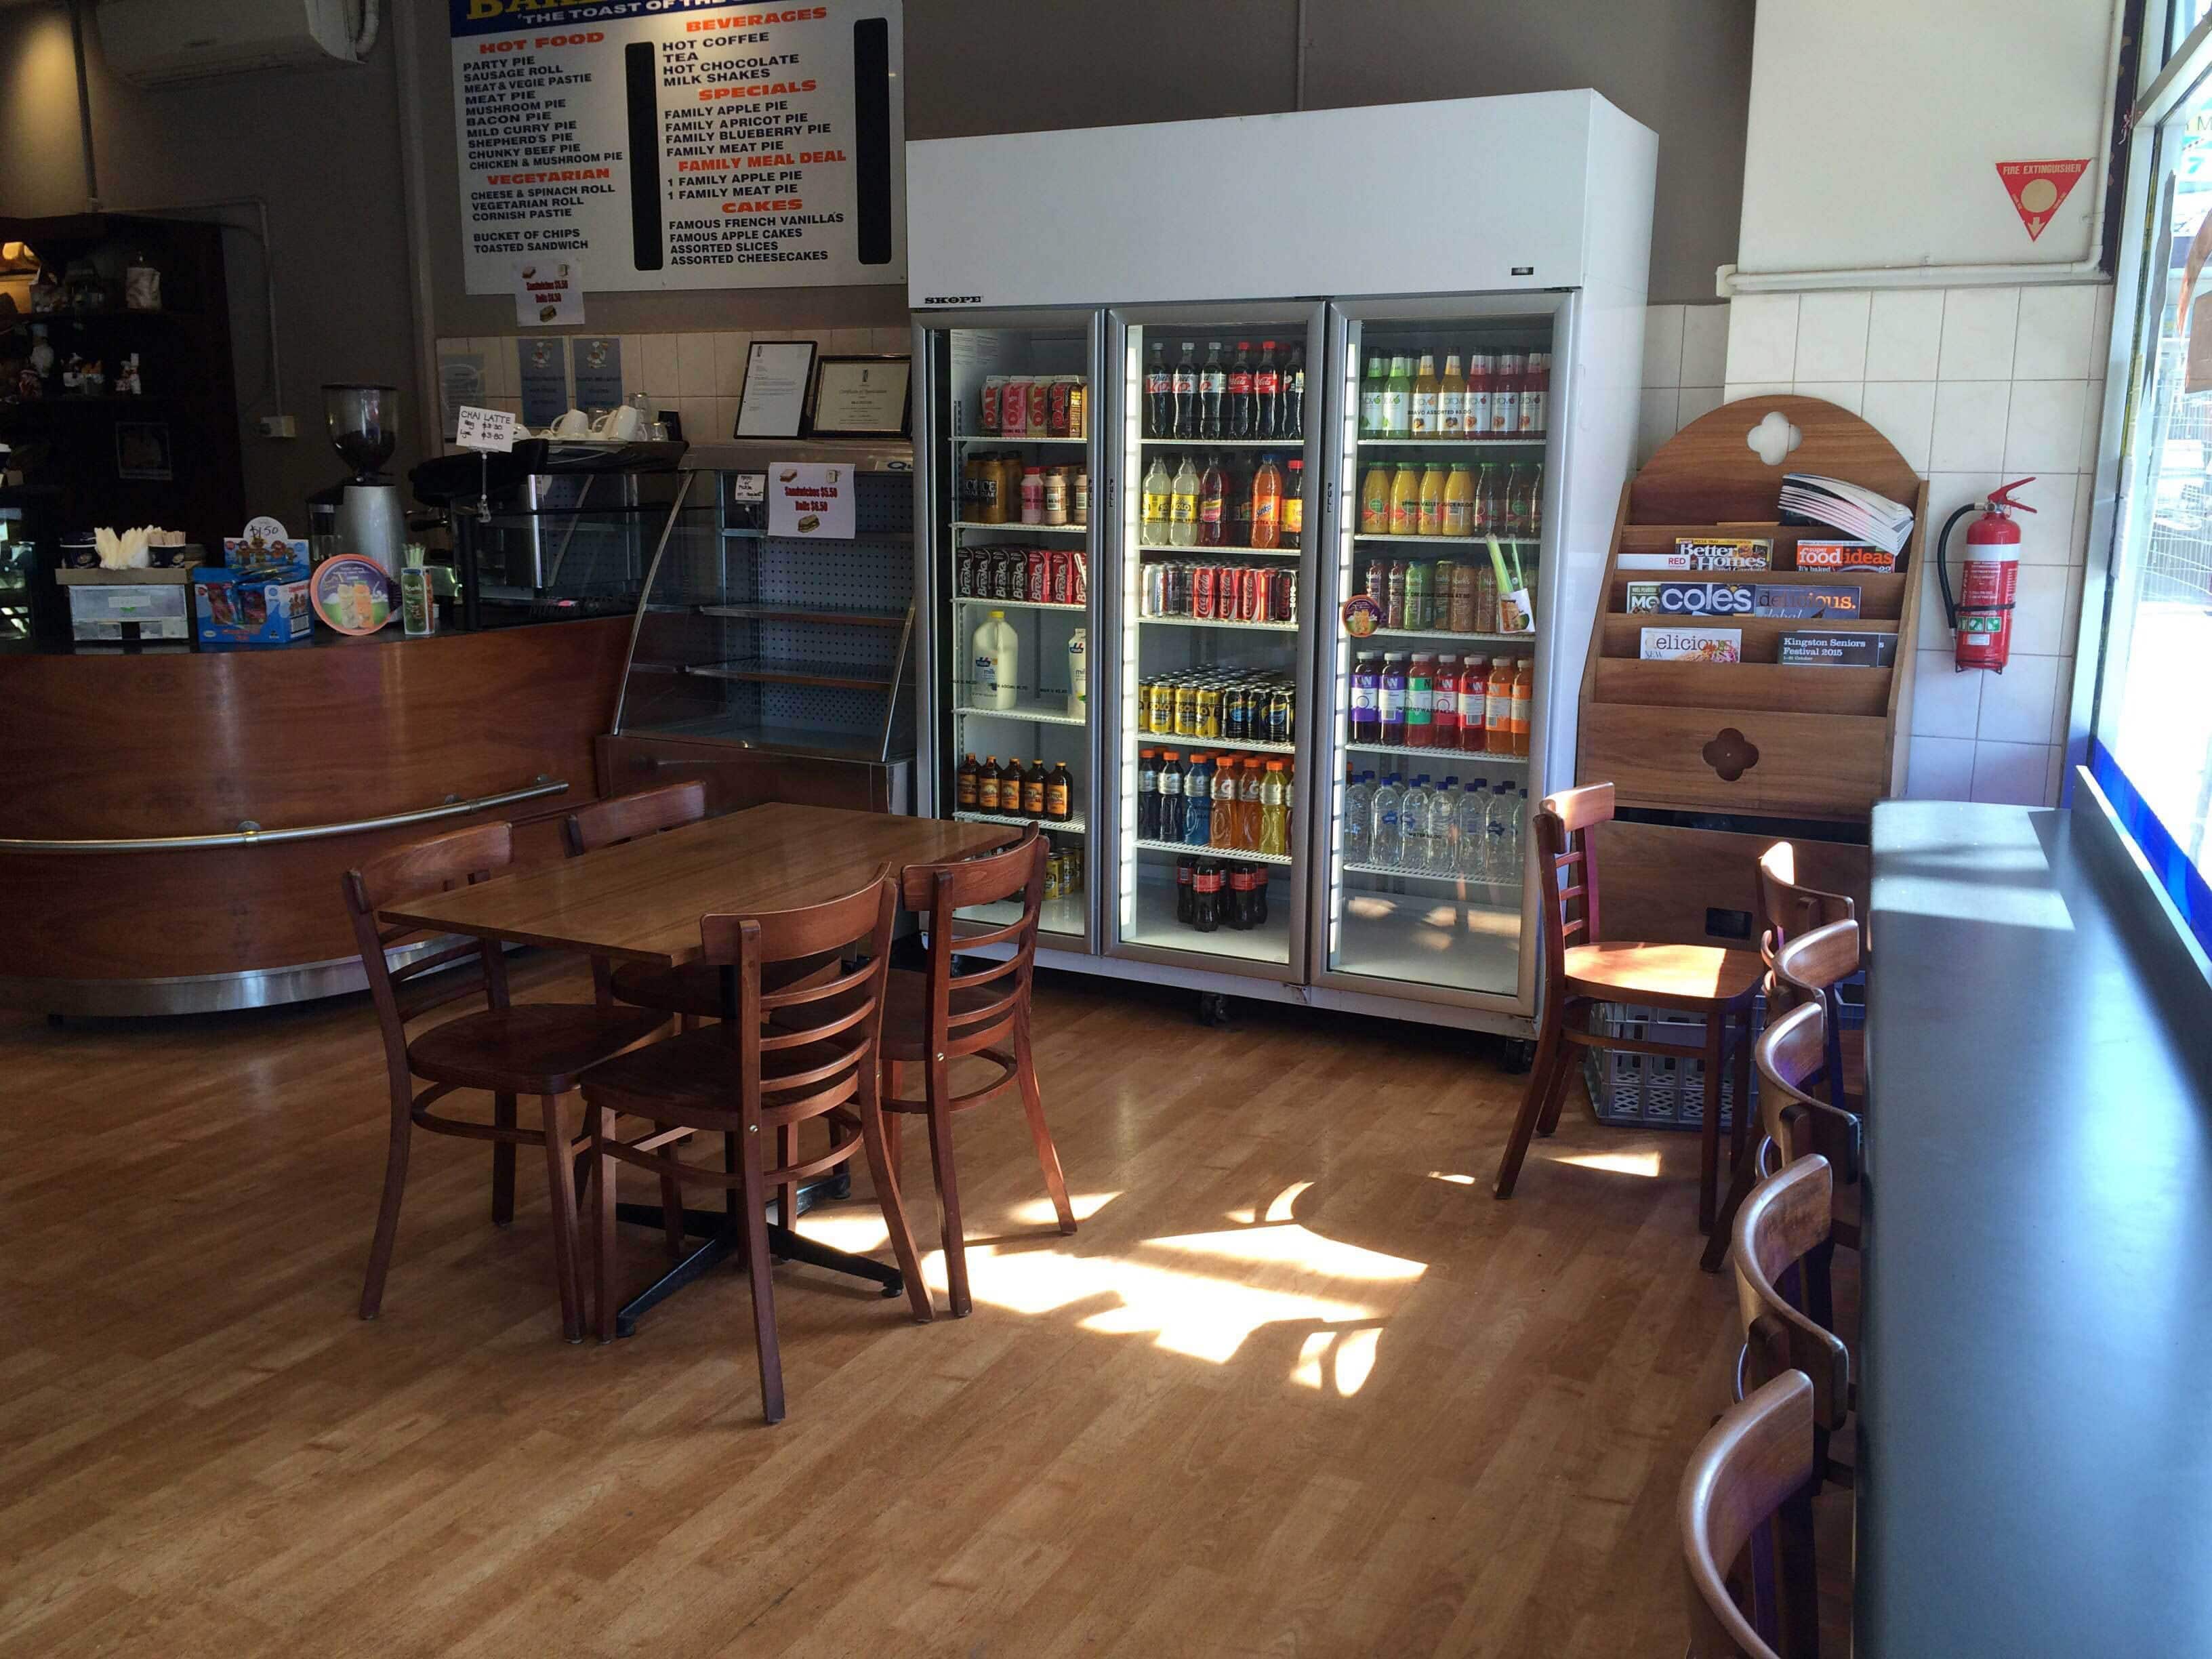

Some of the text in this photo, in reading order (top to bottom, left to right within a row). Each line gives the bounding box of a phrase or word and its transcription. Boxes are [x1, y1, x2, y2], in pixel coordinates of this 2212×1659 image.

[568, 3, 640, 18] TOAST
[646, 0, 674, 10] OF
[687, 7, 826, 33] BEVERAGES
[480, 33, 604, 54] HOT FOOD
[663, 32, 769, 52] HOT COFFEE
[464, 56, 535, 71] PARTY PIE
[663, 53, 699, 62] TEA
[663, 54, 799, 75] HOT CHOCOLATE
[464, 66, 562, 82] SAUSAGE ROLL
[664, 68, 771, 87] MILK SHAKES
[465, 73, 592, 94] MEAT & VEGIE PASTIE
[699, 79, 817, 100] SPECIALS
[466, 91, 535, 104] MEAT PIE
[466, 100, 565, 115] MUSHROOM PIE
[665, 100, 787, 119] FAMILY APPLE PIE
[466, 112, 552, 126] BACON PIE
[665, 113, 808, 131] FAMILY APRICOT PIE
[468, 121, 577, 138] MILD CURRY PIE
[665, 123, 831, 144] FAMILY BLUEBERRY PIE
[468, 133, 572, 148] SHEPHERD'S PIE
[468, 144, 580, 159] CHUNKY BEEF PIE
[666, 141, 784, 157] FAMILY MEAT PIE
[470, 152, 623, 170] CHICKEN & MUSHROOM PIE
[678, 150, 846, 171] FAMILY MEAL DEAL
[488, 168, 609, 184] VEGETARIAN
[2003, 164, 2082, 175] FIRE EXTINGUISHER
[668, 171, 802, 186] 1 FAMILY APPLE PIE
[471, 184, 615, 200] CHEESE & SPINACH ROLL
[668, 184, 798, 199] 1 FAMILY MEAT PIE
[472, 197, 584, 211] VEGETARIAN ROLL
[722, 199, 802, 213] CAKES
[473, 209, 572, 221] CORNISH PASTIE
[670, 212, 844, 230] FAMOUS FRENCH VANILLA'S
[474, 229, 580, 242] BUCKET OF CHIPS
[670, 228, 802, 243] FAMOUS APPLE CAKES
[474, 240, 588, 253] TOASTED SANDWICH
[670, 242, 778, 253] ASSORTED SLICES
[671, 251, 828, 265] ASSORTED CHEESECAKES
[461, 411, 510, 424] CHAI LATTE
[1680, 544, 1739, 557] Better
[1799, 547, 1893, 565] food ideas
[1698, 556, 1767, 571] Homes
[1661, 584, 1753, 612] coles
[1784, 638, 1866, 647] Kingston Seniors
[1784, 647, 1843, 657] Festival 2015
